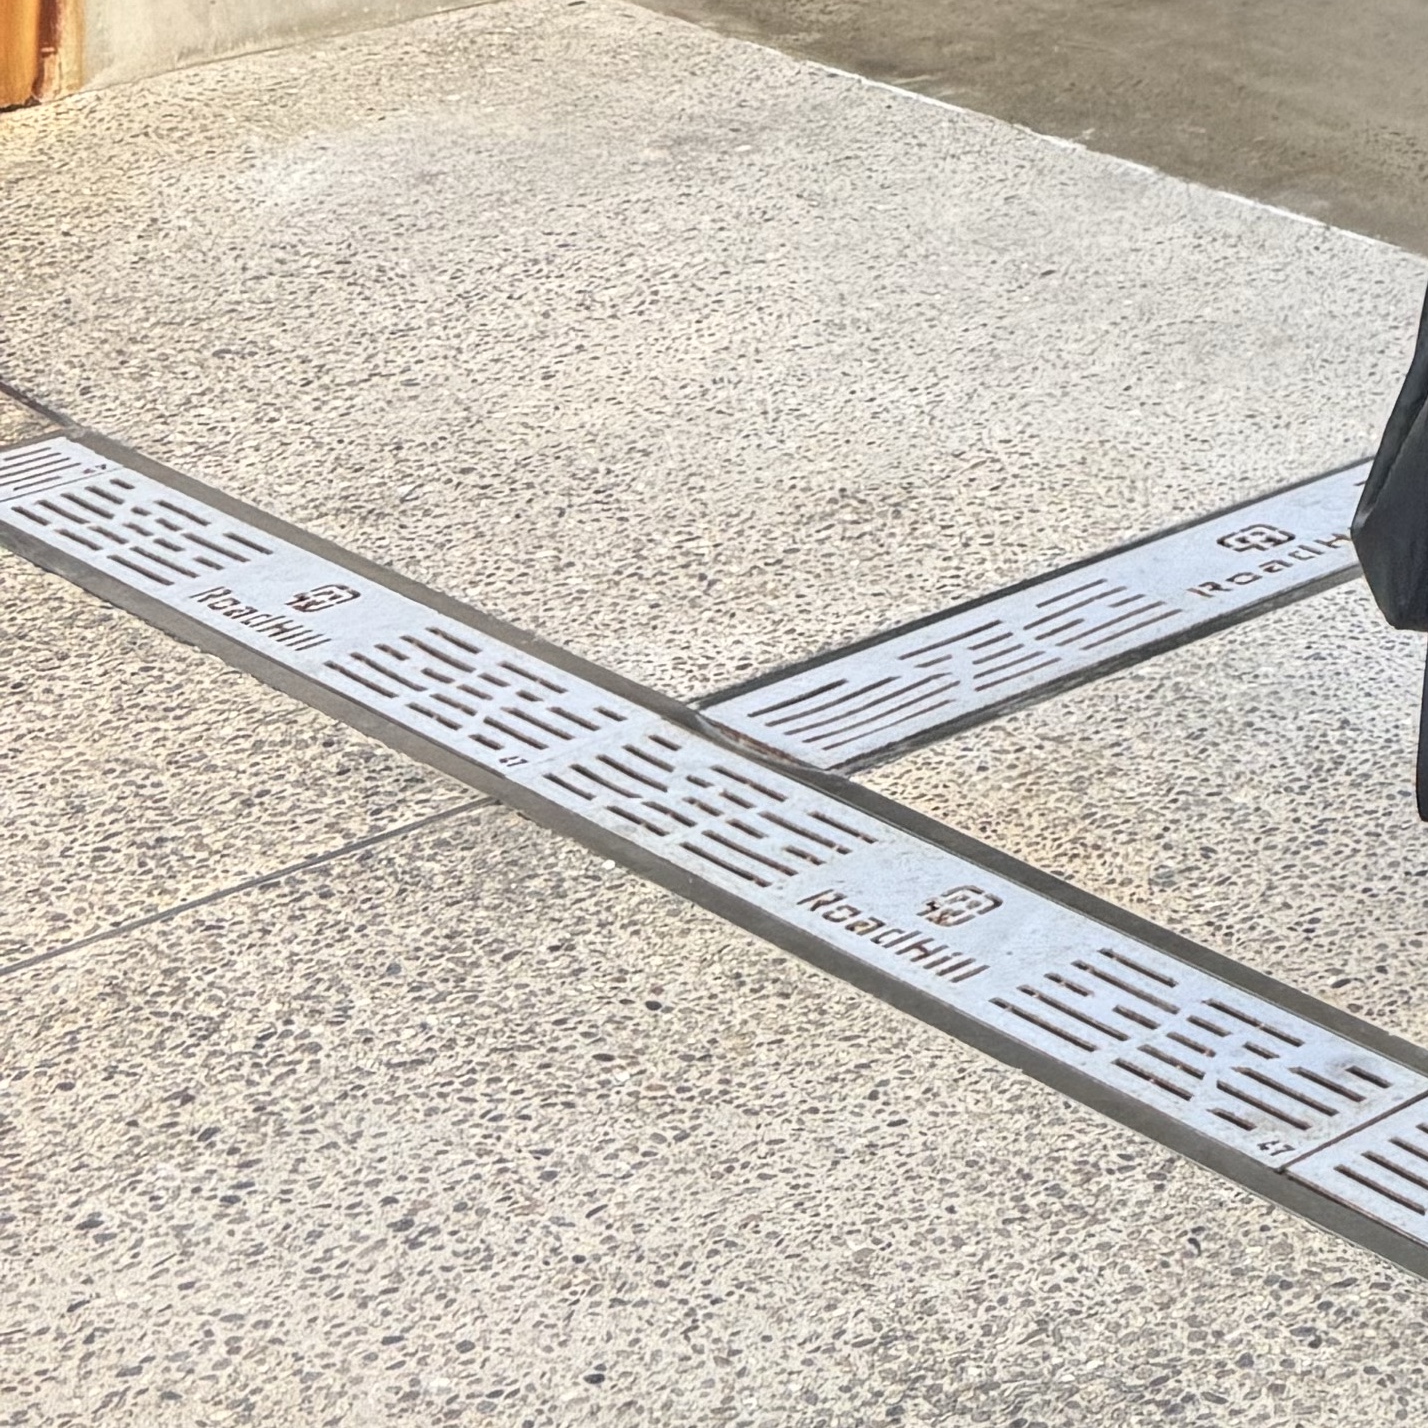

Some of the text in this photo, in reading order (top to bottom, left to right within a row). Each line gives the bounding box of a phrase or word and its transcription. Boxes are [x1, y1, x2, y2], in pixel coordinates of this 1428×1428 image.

[1187, 532, 1352, 597] RoadH
[188, 586, 332, 651] RoadHill
[796, 888, 990, 983] RoadHill
